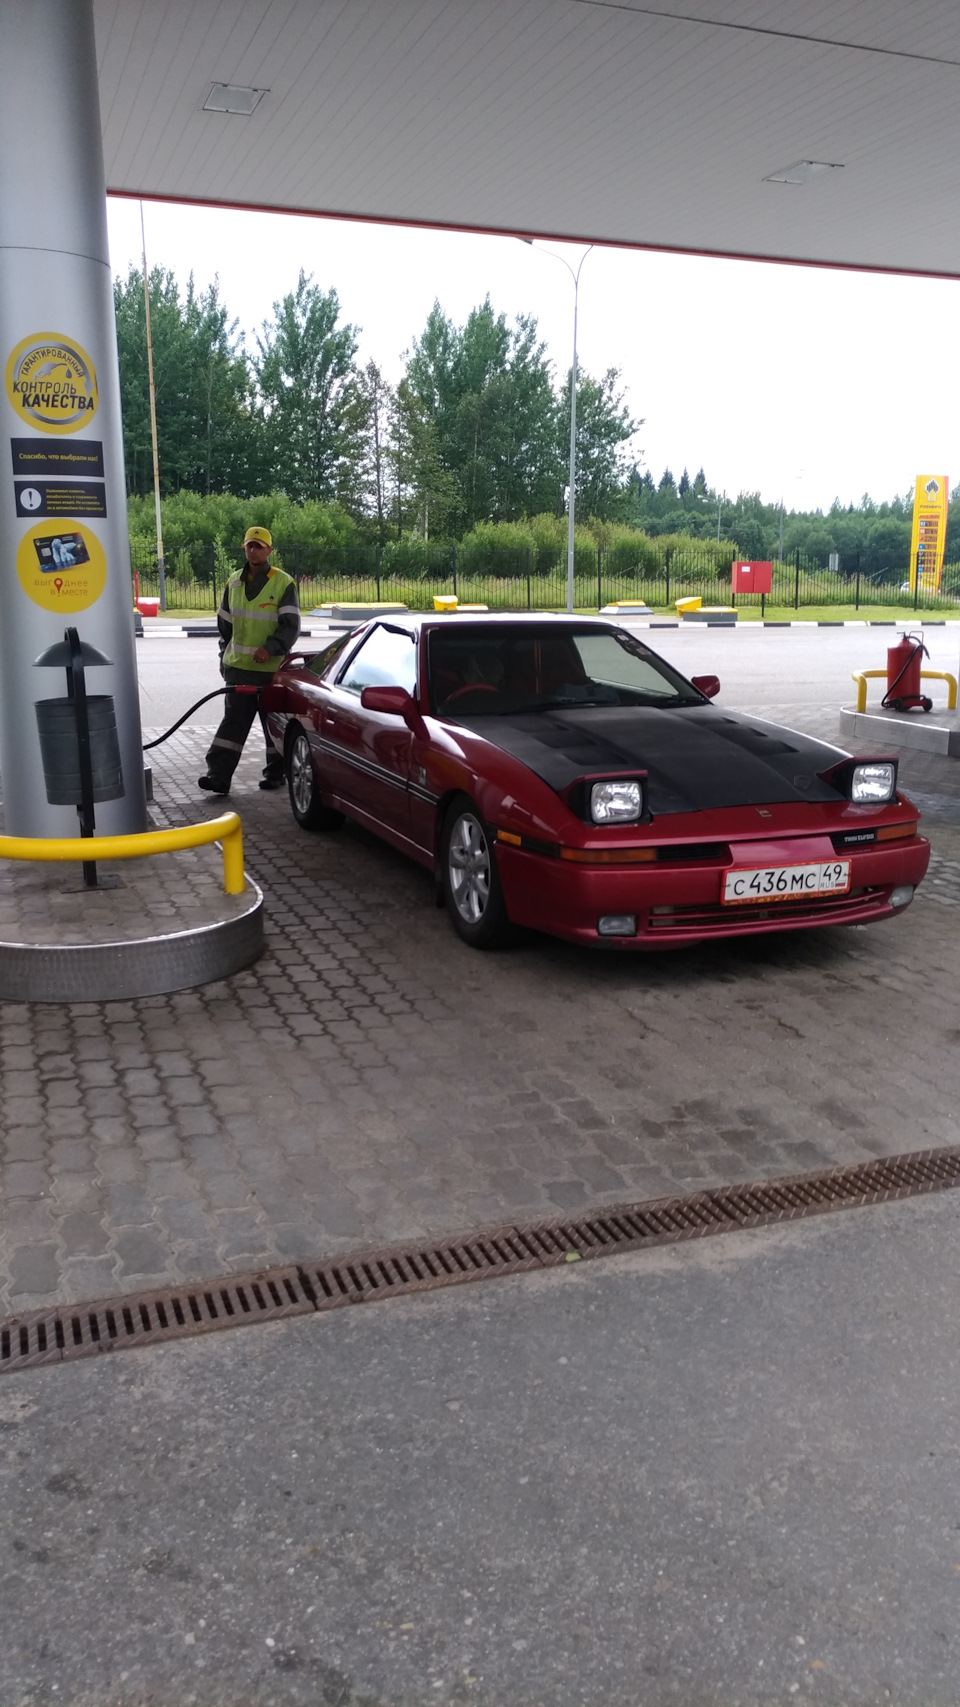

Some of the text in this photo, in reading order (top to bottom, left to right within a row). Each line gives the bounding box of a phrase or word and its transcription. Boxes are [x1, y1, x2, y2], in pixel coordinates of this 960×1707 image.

[21, 348, 85, 378] ГАРАНТИРОВАННЫЙ
[13, 381, 77, 395] КОНТРОЛЬ
[22, 394, 94, 410] КАЧЕСТВА
[823, 864, 843, 881] 49
[820, 881, 835, 889] RUS
